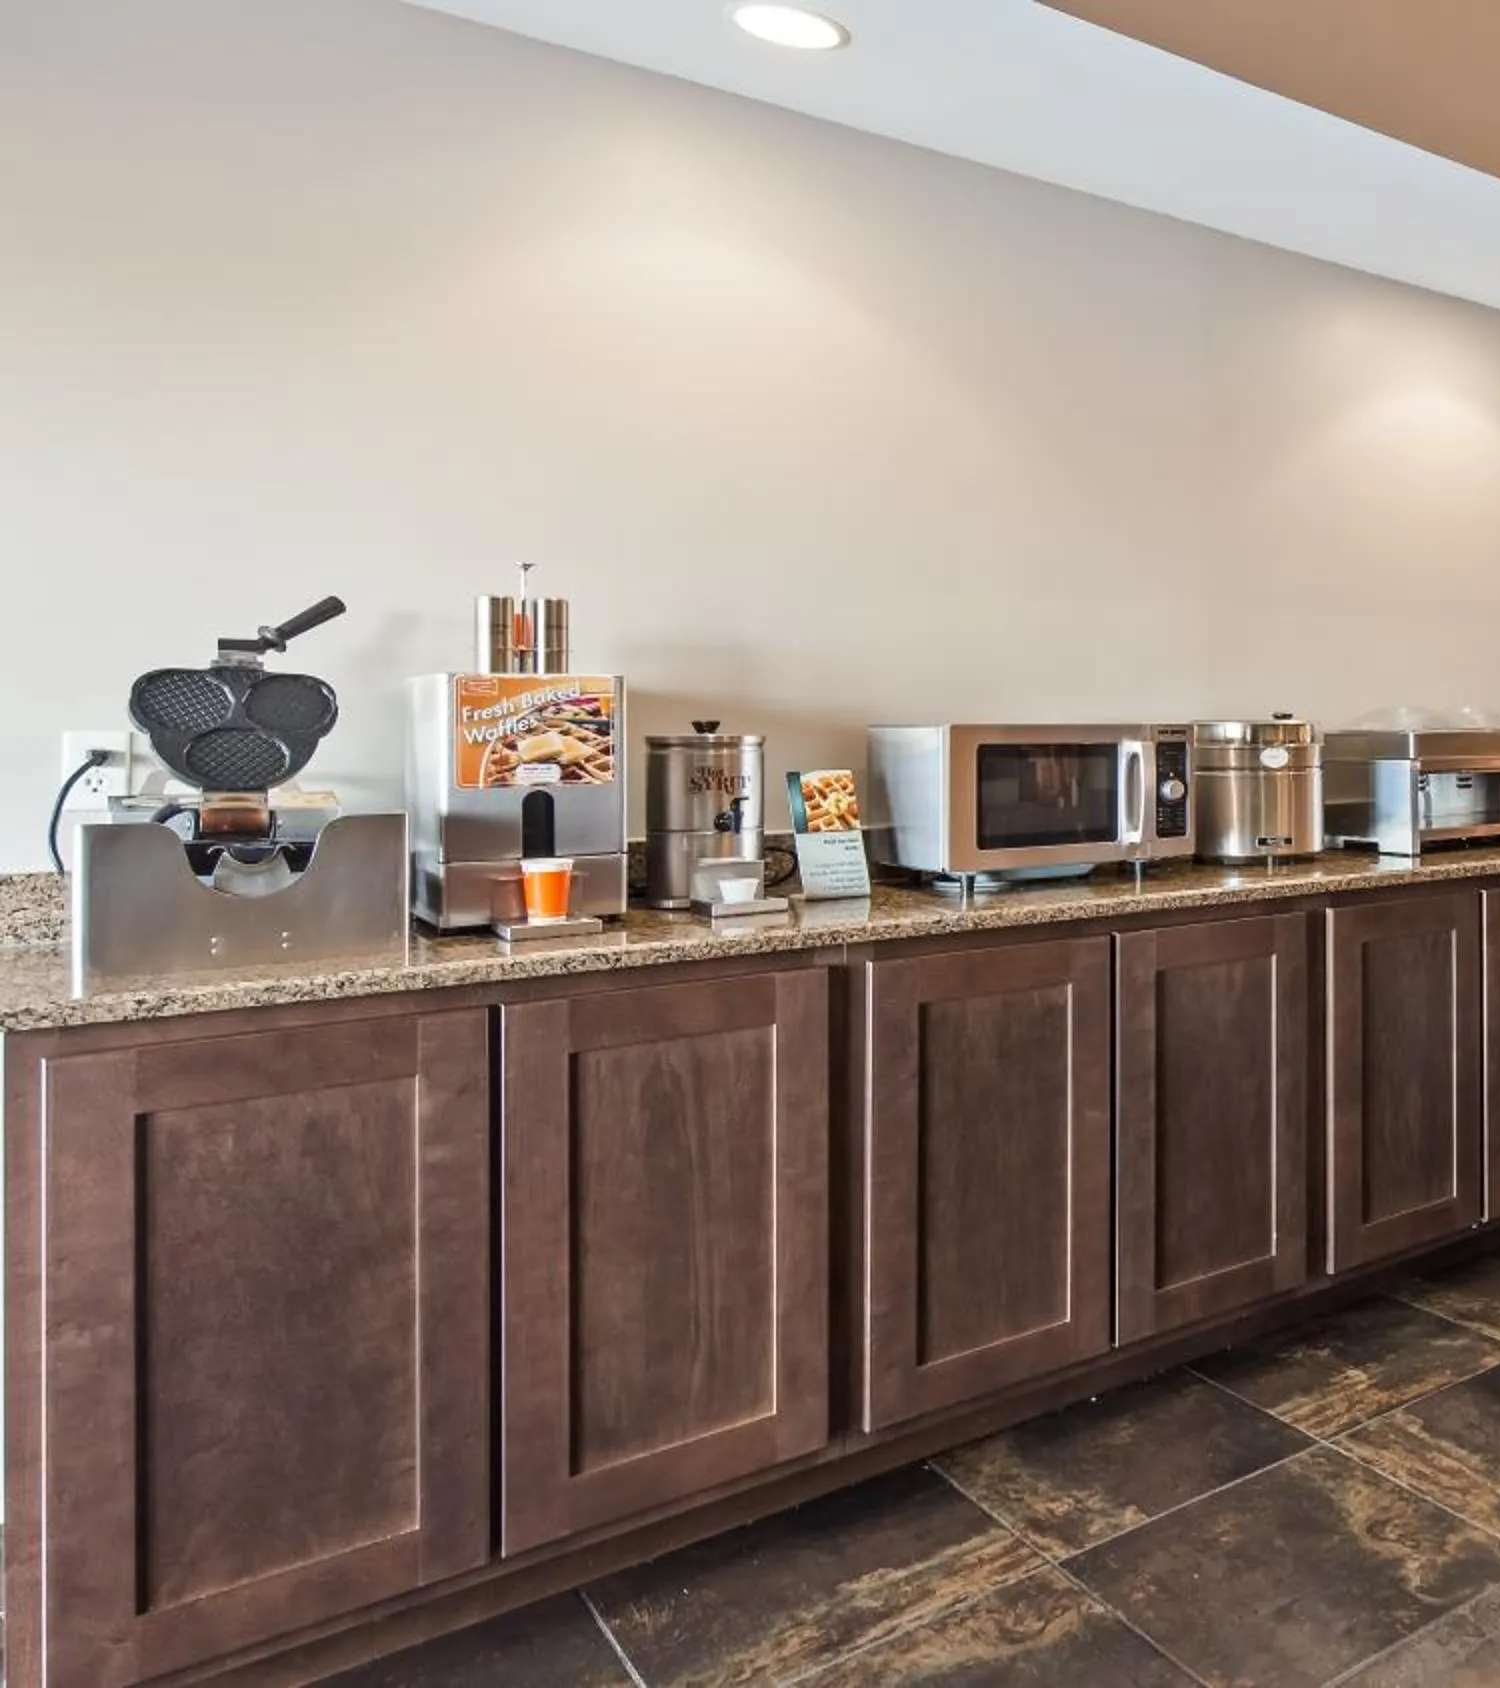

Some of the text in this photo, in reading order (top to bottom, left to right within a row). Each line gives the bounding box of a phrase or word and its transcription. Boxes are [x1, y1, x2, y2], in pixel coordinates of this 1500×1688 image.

[462, 697, 515, 723] Fresh
[521, 680, 580, 707] Baked
[463, 715, 539, 744] Waffles
